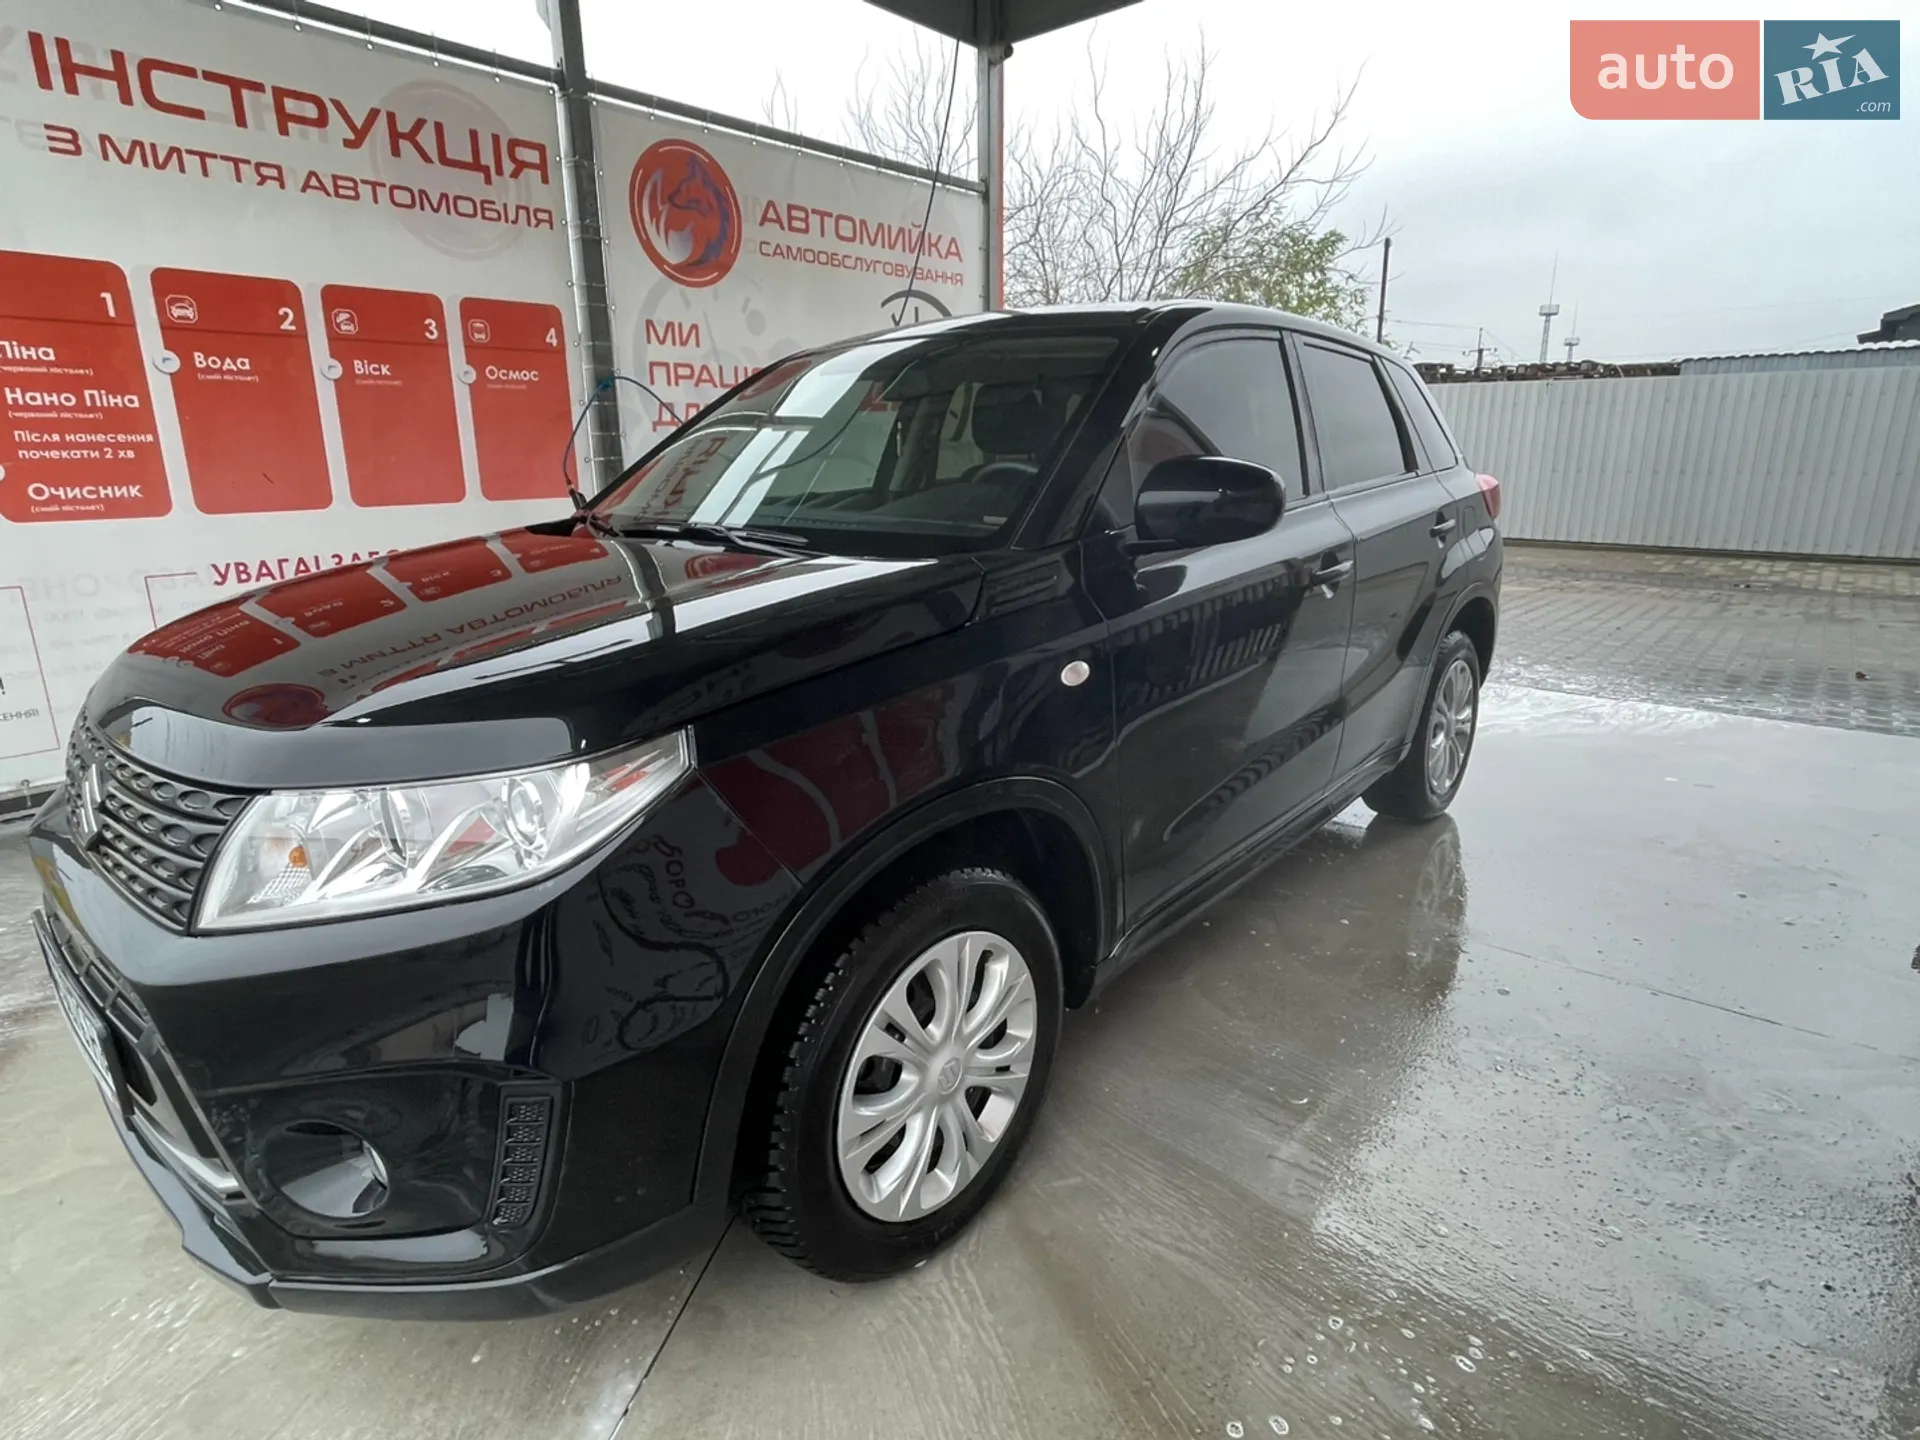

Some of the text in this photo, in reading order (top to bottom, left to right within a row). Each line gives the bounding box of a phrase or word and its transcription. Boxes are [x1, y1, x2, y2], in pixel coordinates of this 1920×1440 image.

[27, 30, 550, 186] ІНСТРУКЦІЯ
[44, 123, 554, 231] З МИТТЯ АВТОМОБІЛЯ
[758, 199, 963, 263] АВТОМИЙКА
[758, 240, 964, 287] САМООБСЛУГОВУВАННЯ
[100, 291, 116, 318] 1
[278, 307, 297, 331] 2
[424, 318, 439, 340] 3
[545, 327, 558, 347] 4
[645, 319, 701, 348] МИ
[0, 340, 56, 361] Піна
[193, 351, 251, 371] Вода
[353, 359, 391, 376] Віск
[485, 365, 539, 381] Осмос
[4, 387, 140, 408] Нано Піна
[652, 402, 704, 432] ДЛ
[14, 430, 154, 443] Після нанесення
[18, 447, 135, 459] почекати 2 хв
[27, 482, 143, 501] Очисник
